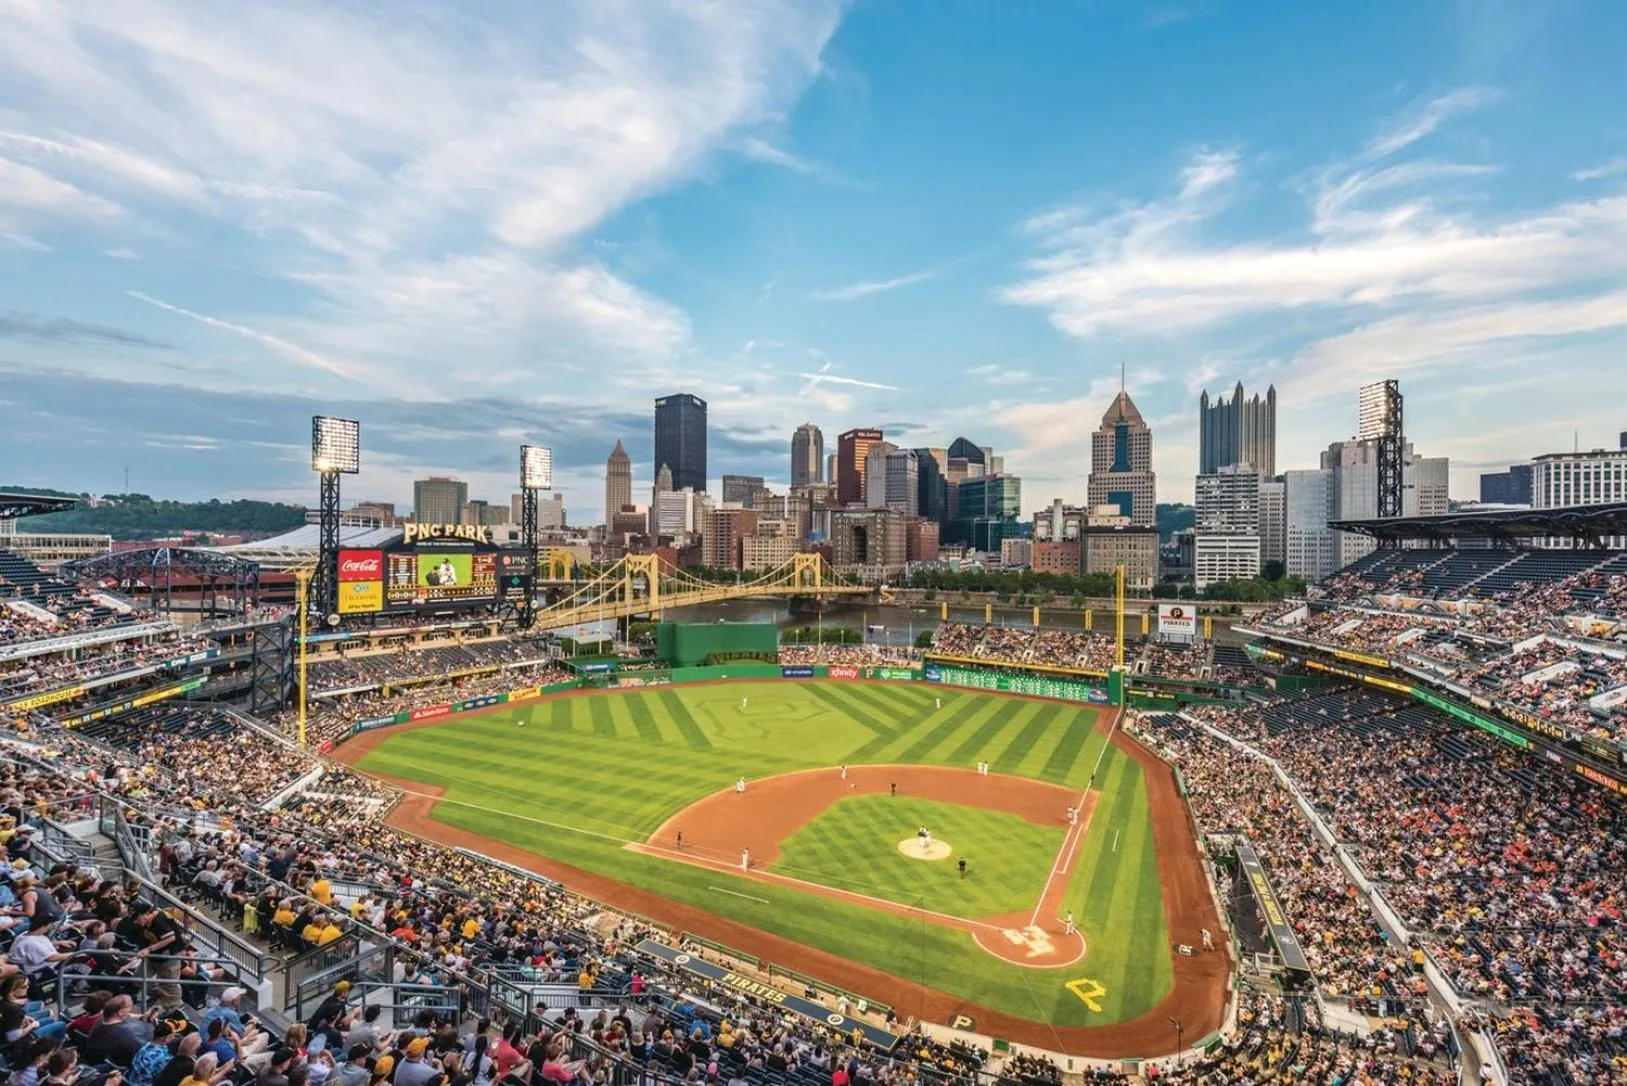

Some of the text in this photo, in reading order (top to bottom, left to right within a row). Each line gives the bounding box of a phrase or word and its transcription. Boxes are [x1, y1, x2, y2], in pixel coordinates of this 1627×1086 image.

[403, 522, 489, 545] PNC PARK
[342, 558, 379, 571] Coca-Cola
[831, 668, 858, 679] xfinity
[866, 668, 874, 679] P
[721, 972, 788, 1003] PIRATES
[1065, 978, 1107, 1012] P
[951, 1014, 973, 1030] P
